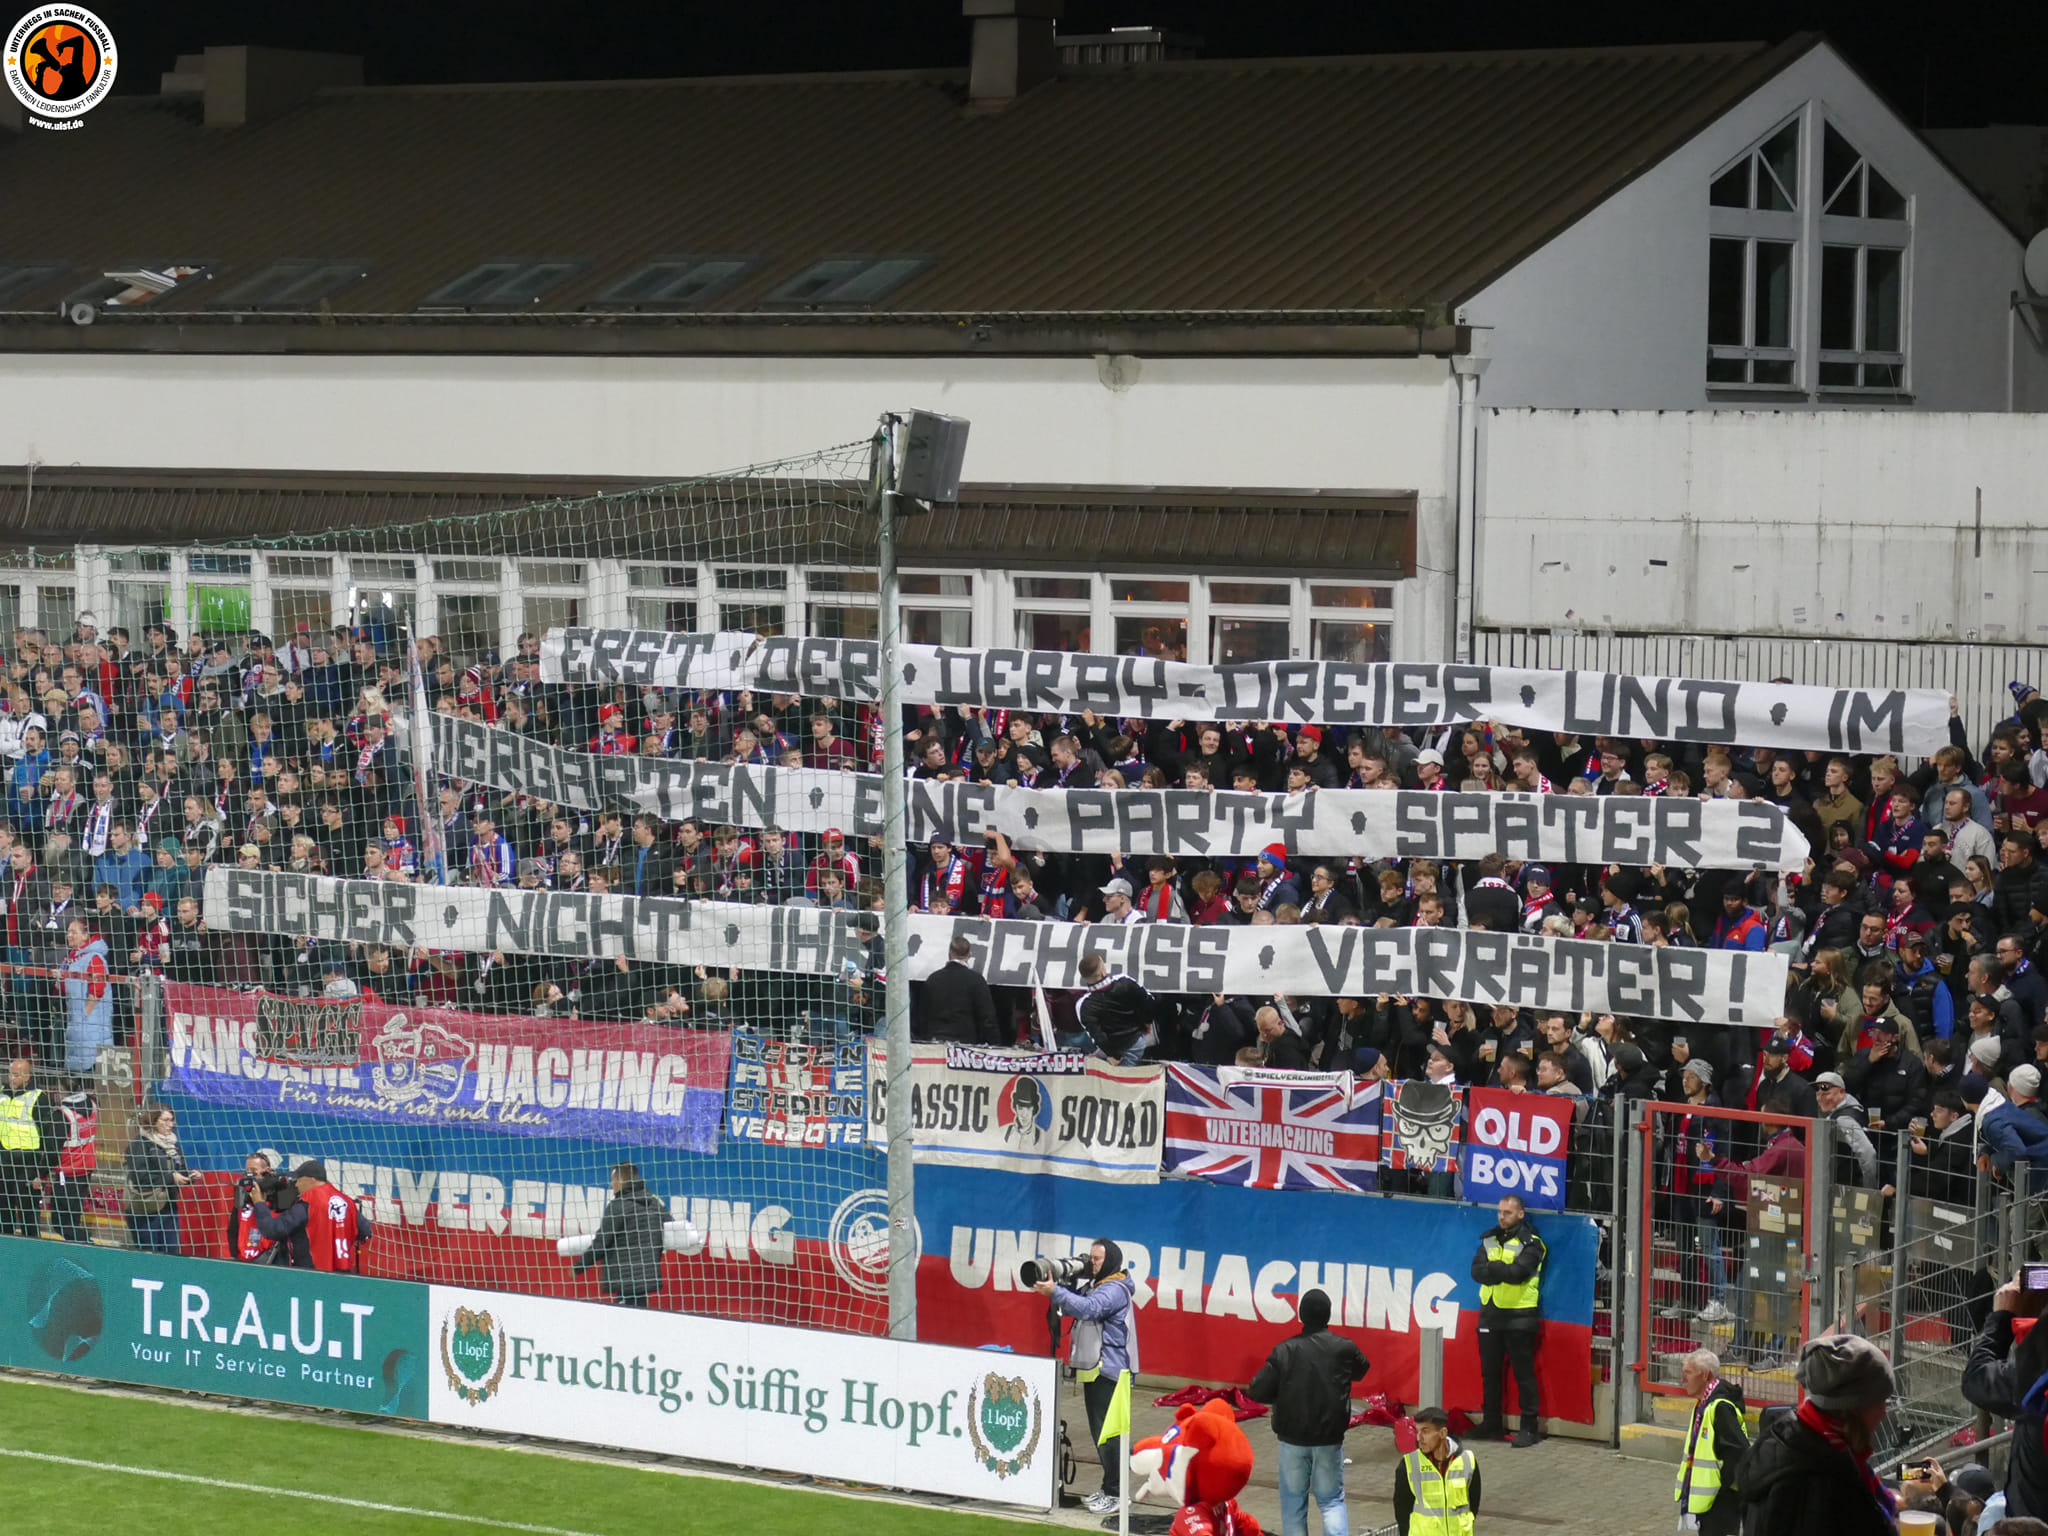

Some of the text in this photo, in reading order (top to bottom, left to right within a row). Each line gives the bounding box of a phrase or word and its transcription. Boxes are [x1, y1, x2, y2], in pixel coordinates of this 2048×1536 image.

[561, 628, 716, 686] ERST
[753, 636, 882, 700] DER
[1563, 670, 1740, 742] UND
[1827, 688, 1907, 753] IM
[1066, 788, 1315, 856] PARTY
[227, 870, 417, 945] SICHER
[486, 890, 692, 963] NICHT
[96, 1050, 132, 1088] 15
[735, 1035, 864, 1068] GEGEN
[280, 1075, 319, 1104] Für
[326, 1087, 399, 1114] immer
[474, 1043, 688, 1118] HACHING
[735, 1063, 863, 1092] ALLE
[732, 1088, 863, 1118] STADION
[871, 1079, 1158, 1149] CASSIC SQUAD
[730, 1115, 863, 1144] VERBOTE
[1206, 1118, 1335, 1156] UNTERHACHING
[1474, 1106, 1562, 1155] OLD
[1471, 1152, 1559, 1197] BOYS
[131, 1278, 375, 1361] T.R.A.U.T
[131, 1342, 375, 1389] Your IT Service Partner
[509, 1335, 963, 1447] Fruchtig. Süffig Hopf.
